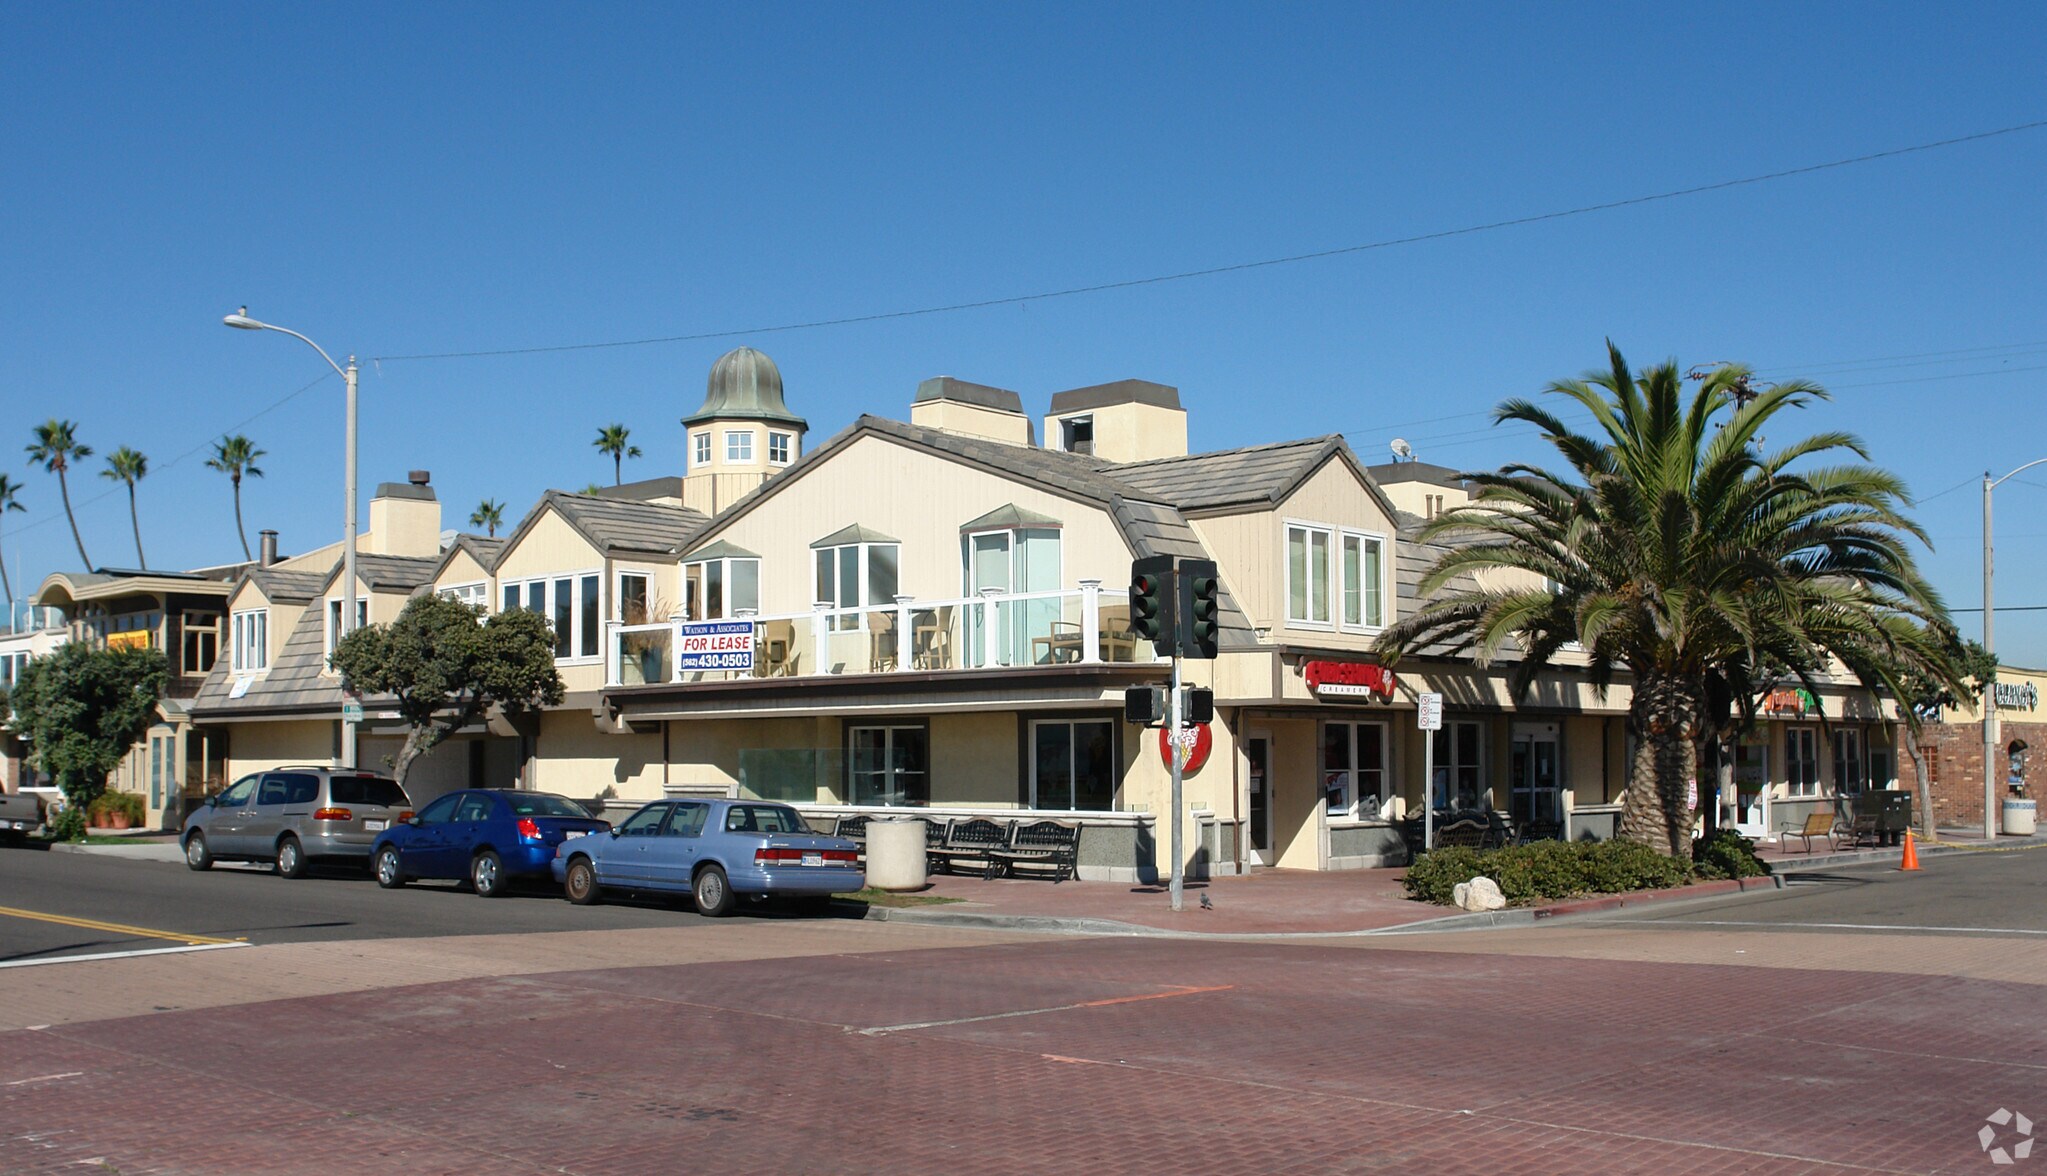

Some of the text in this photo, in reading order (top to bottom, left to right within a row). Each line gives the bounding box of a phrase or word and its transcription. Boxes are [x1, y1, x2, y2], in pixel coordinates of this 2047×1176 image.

[684, 626, 707, 634] WATSON
[716, 624, 749, 633] ASSOCIATES
[684, 636, 750, 651] FOR LEASE
[698, 653, 749, 667] 430-0503
